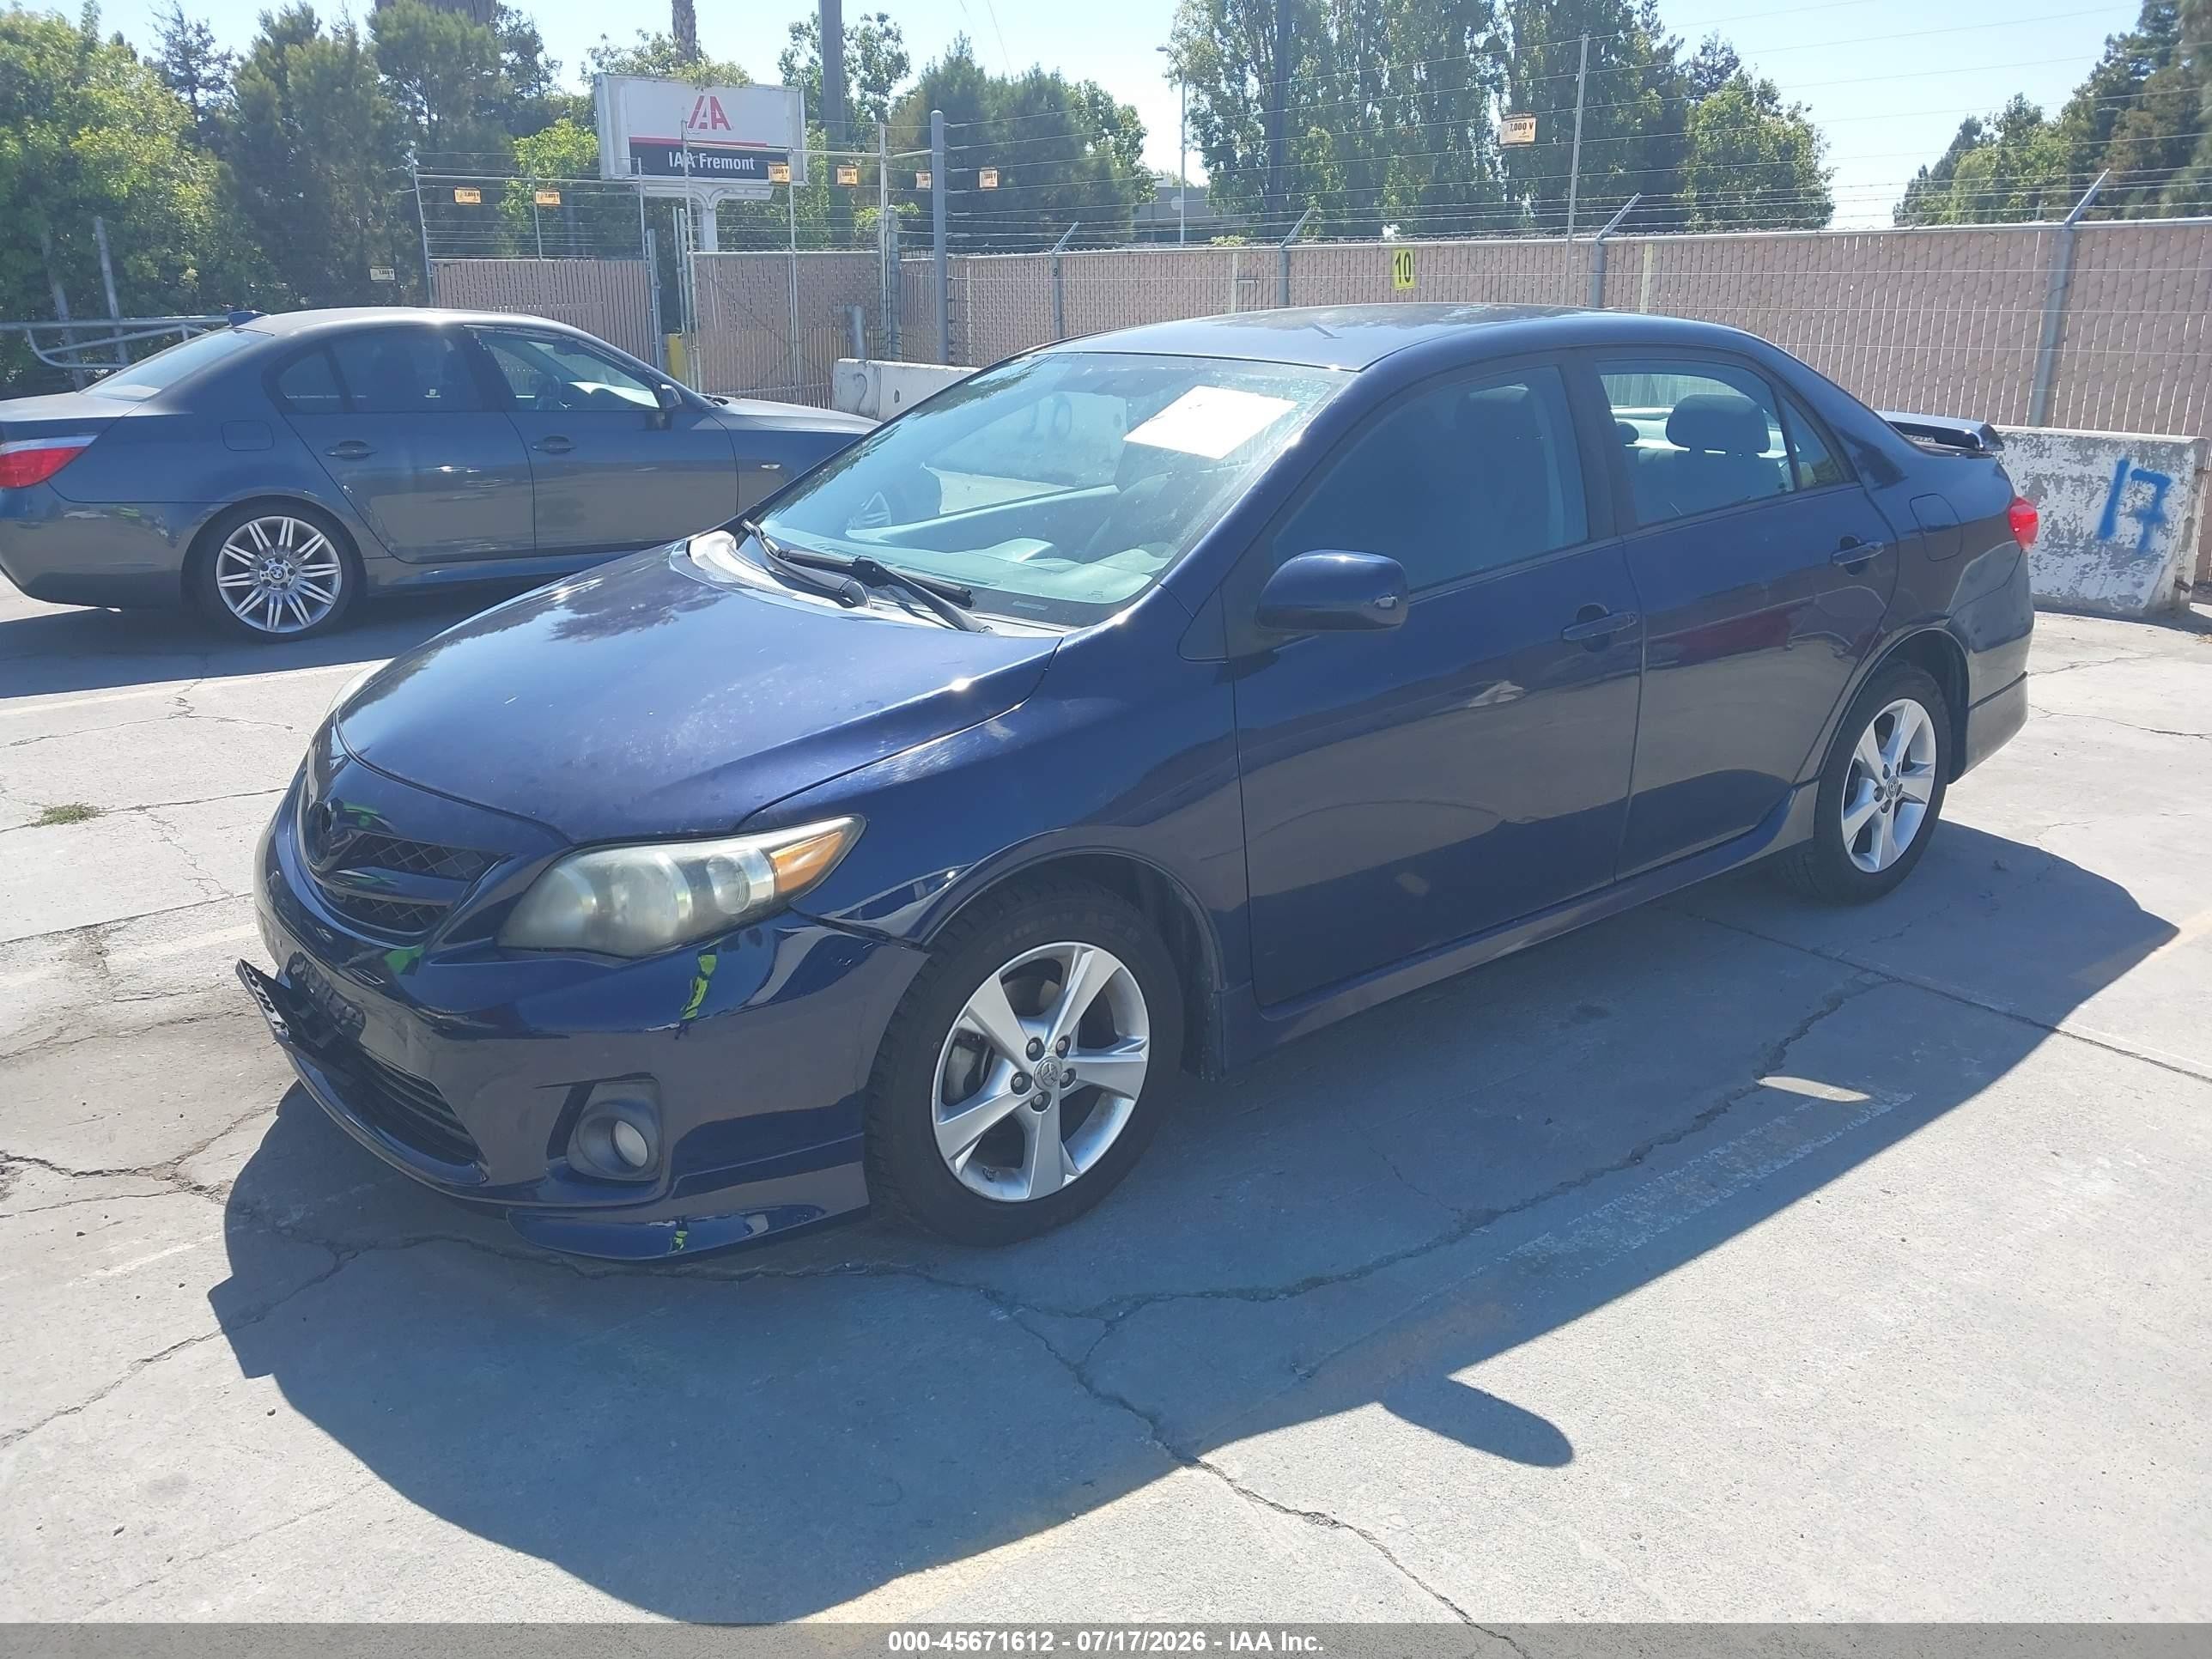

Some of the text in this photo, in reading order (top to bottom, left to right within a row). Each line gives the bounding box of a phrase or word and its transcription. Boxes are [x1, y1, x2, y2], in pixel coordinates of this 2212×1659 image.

[1510, 121, 1534, 132] 7,000 V
[668, 151, 755, 170] IAA Fremont
[1395, 252, 1411, 283] 10
[2095, 456, 2172, 555] 17
